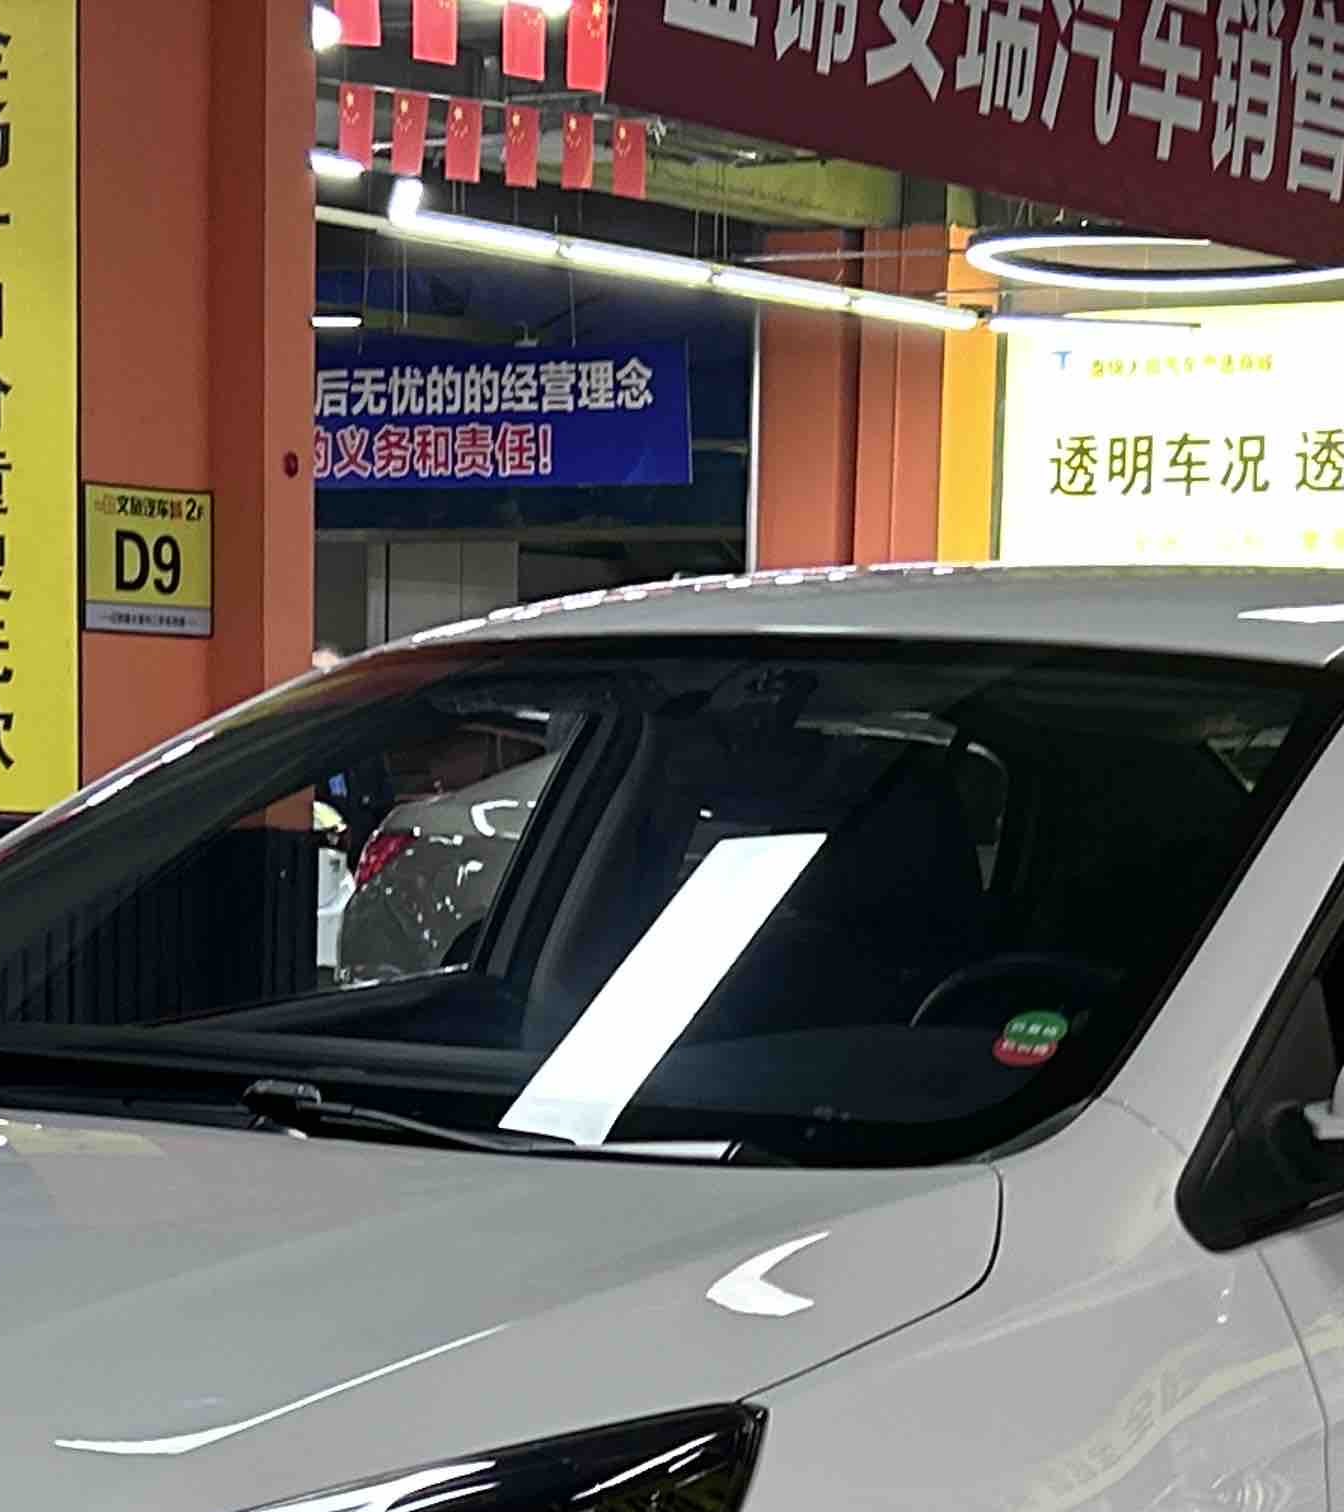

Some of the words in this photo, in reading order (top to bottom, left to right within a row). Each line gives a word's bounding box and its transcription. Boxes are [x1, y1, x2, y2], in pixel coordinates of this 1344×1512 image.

[1050, 432, 1269, 496] 透明车况
[115, 529, 182, 595] D9
